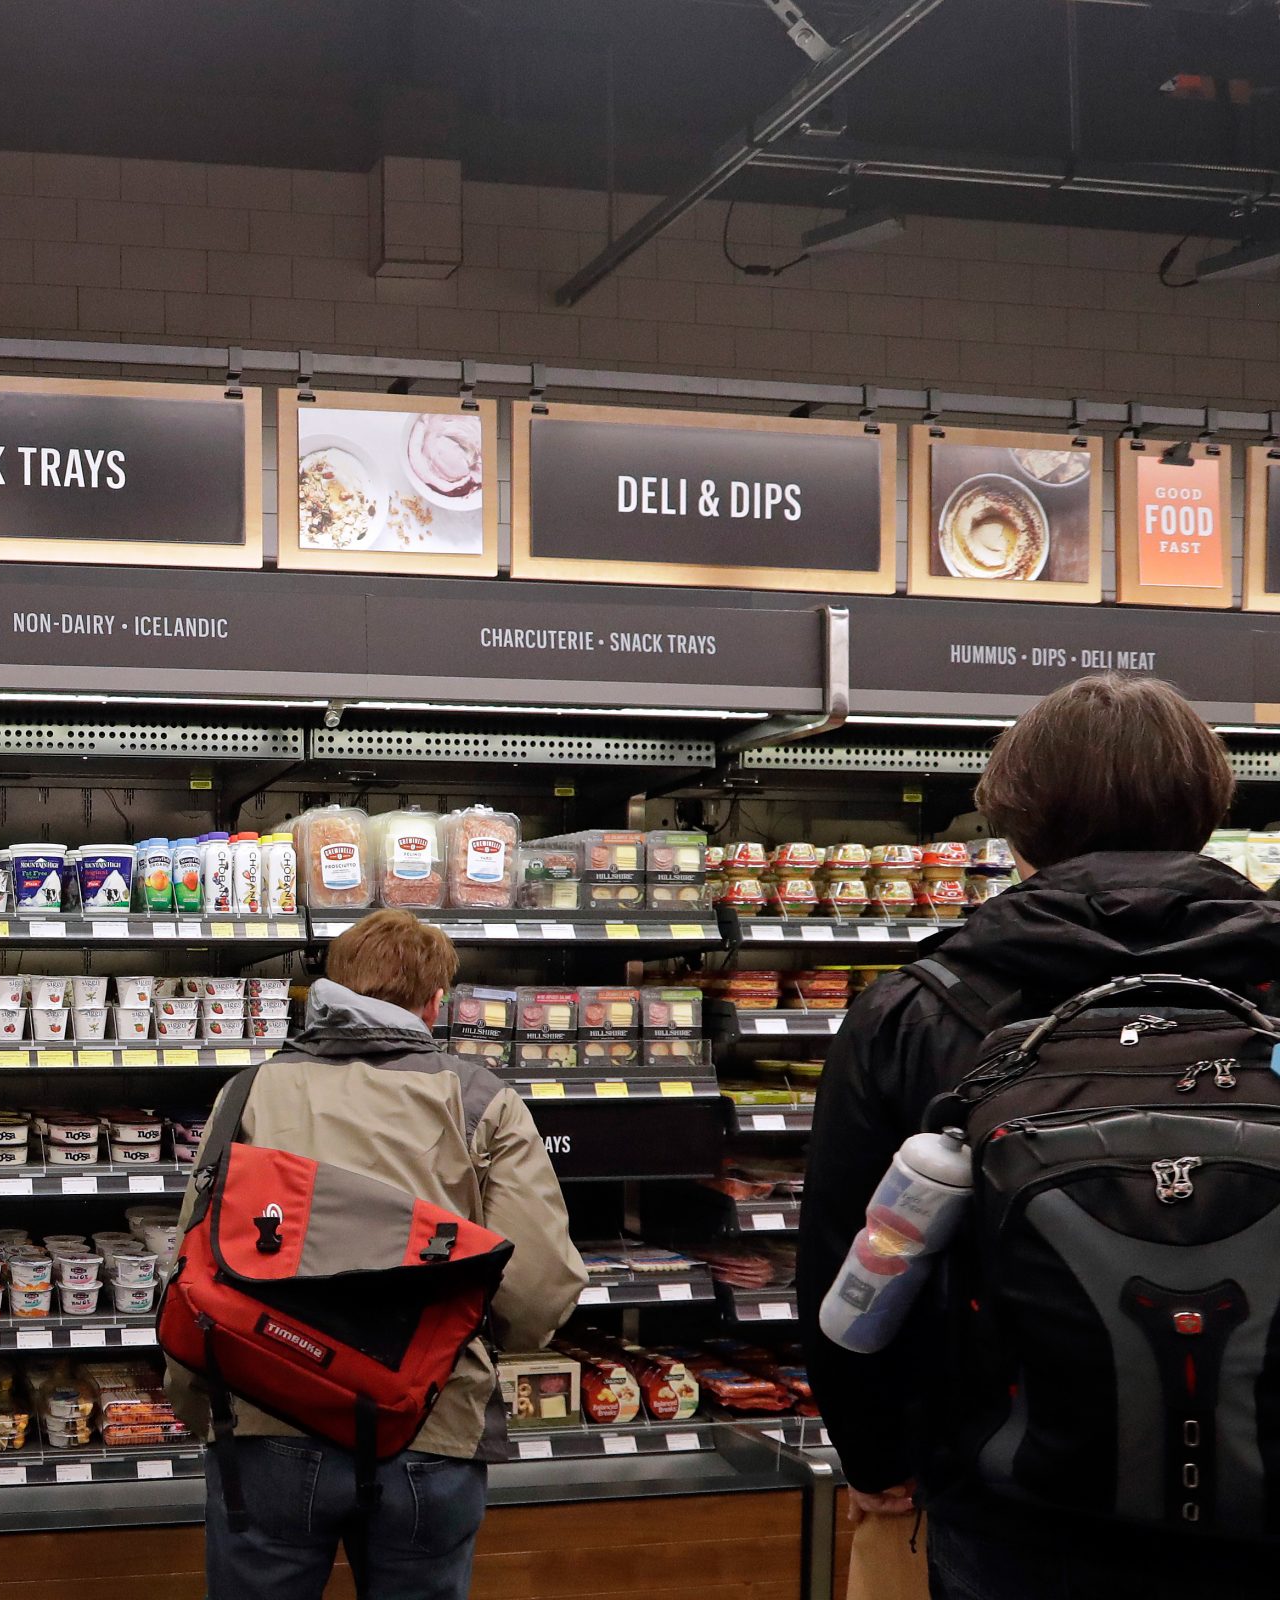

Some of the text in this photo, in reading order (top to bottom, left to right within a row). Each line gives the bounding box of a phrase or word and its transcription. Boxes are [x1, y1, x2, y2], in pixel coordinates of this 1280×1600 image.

[17, 447, 126, 490] TRAYS
[617, 476, 802, 521] DELI & DIPS
[1155, 487, 1203, 501] GOOD
[1145, 504, 1214, 536] FOOD
[1159, 541, 1202, 554] FAST
[13, 613, 228, 639] NON-DAIRY ICELANDIC
[480, 628, 717, 655] CHARCUTERIE SNACK TRAYS
[950, 645, 1156, 671] HUMMUS DIPS DELI MEAT
[462, 1027, 499, 1036] HILLSHIRE
[65, 1131, 91, 1140] noosa
[137, 1129, 160, 1139] noosa
[545, 1136, 570, 1153] AYS
[65, 1152, 91, 1161] noosa
[123, 1151, 150, 1161] noosa
[268, 1323, 323, 1358] TIMBUK2
